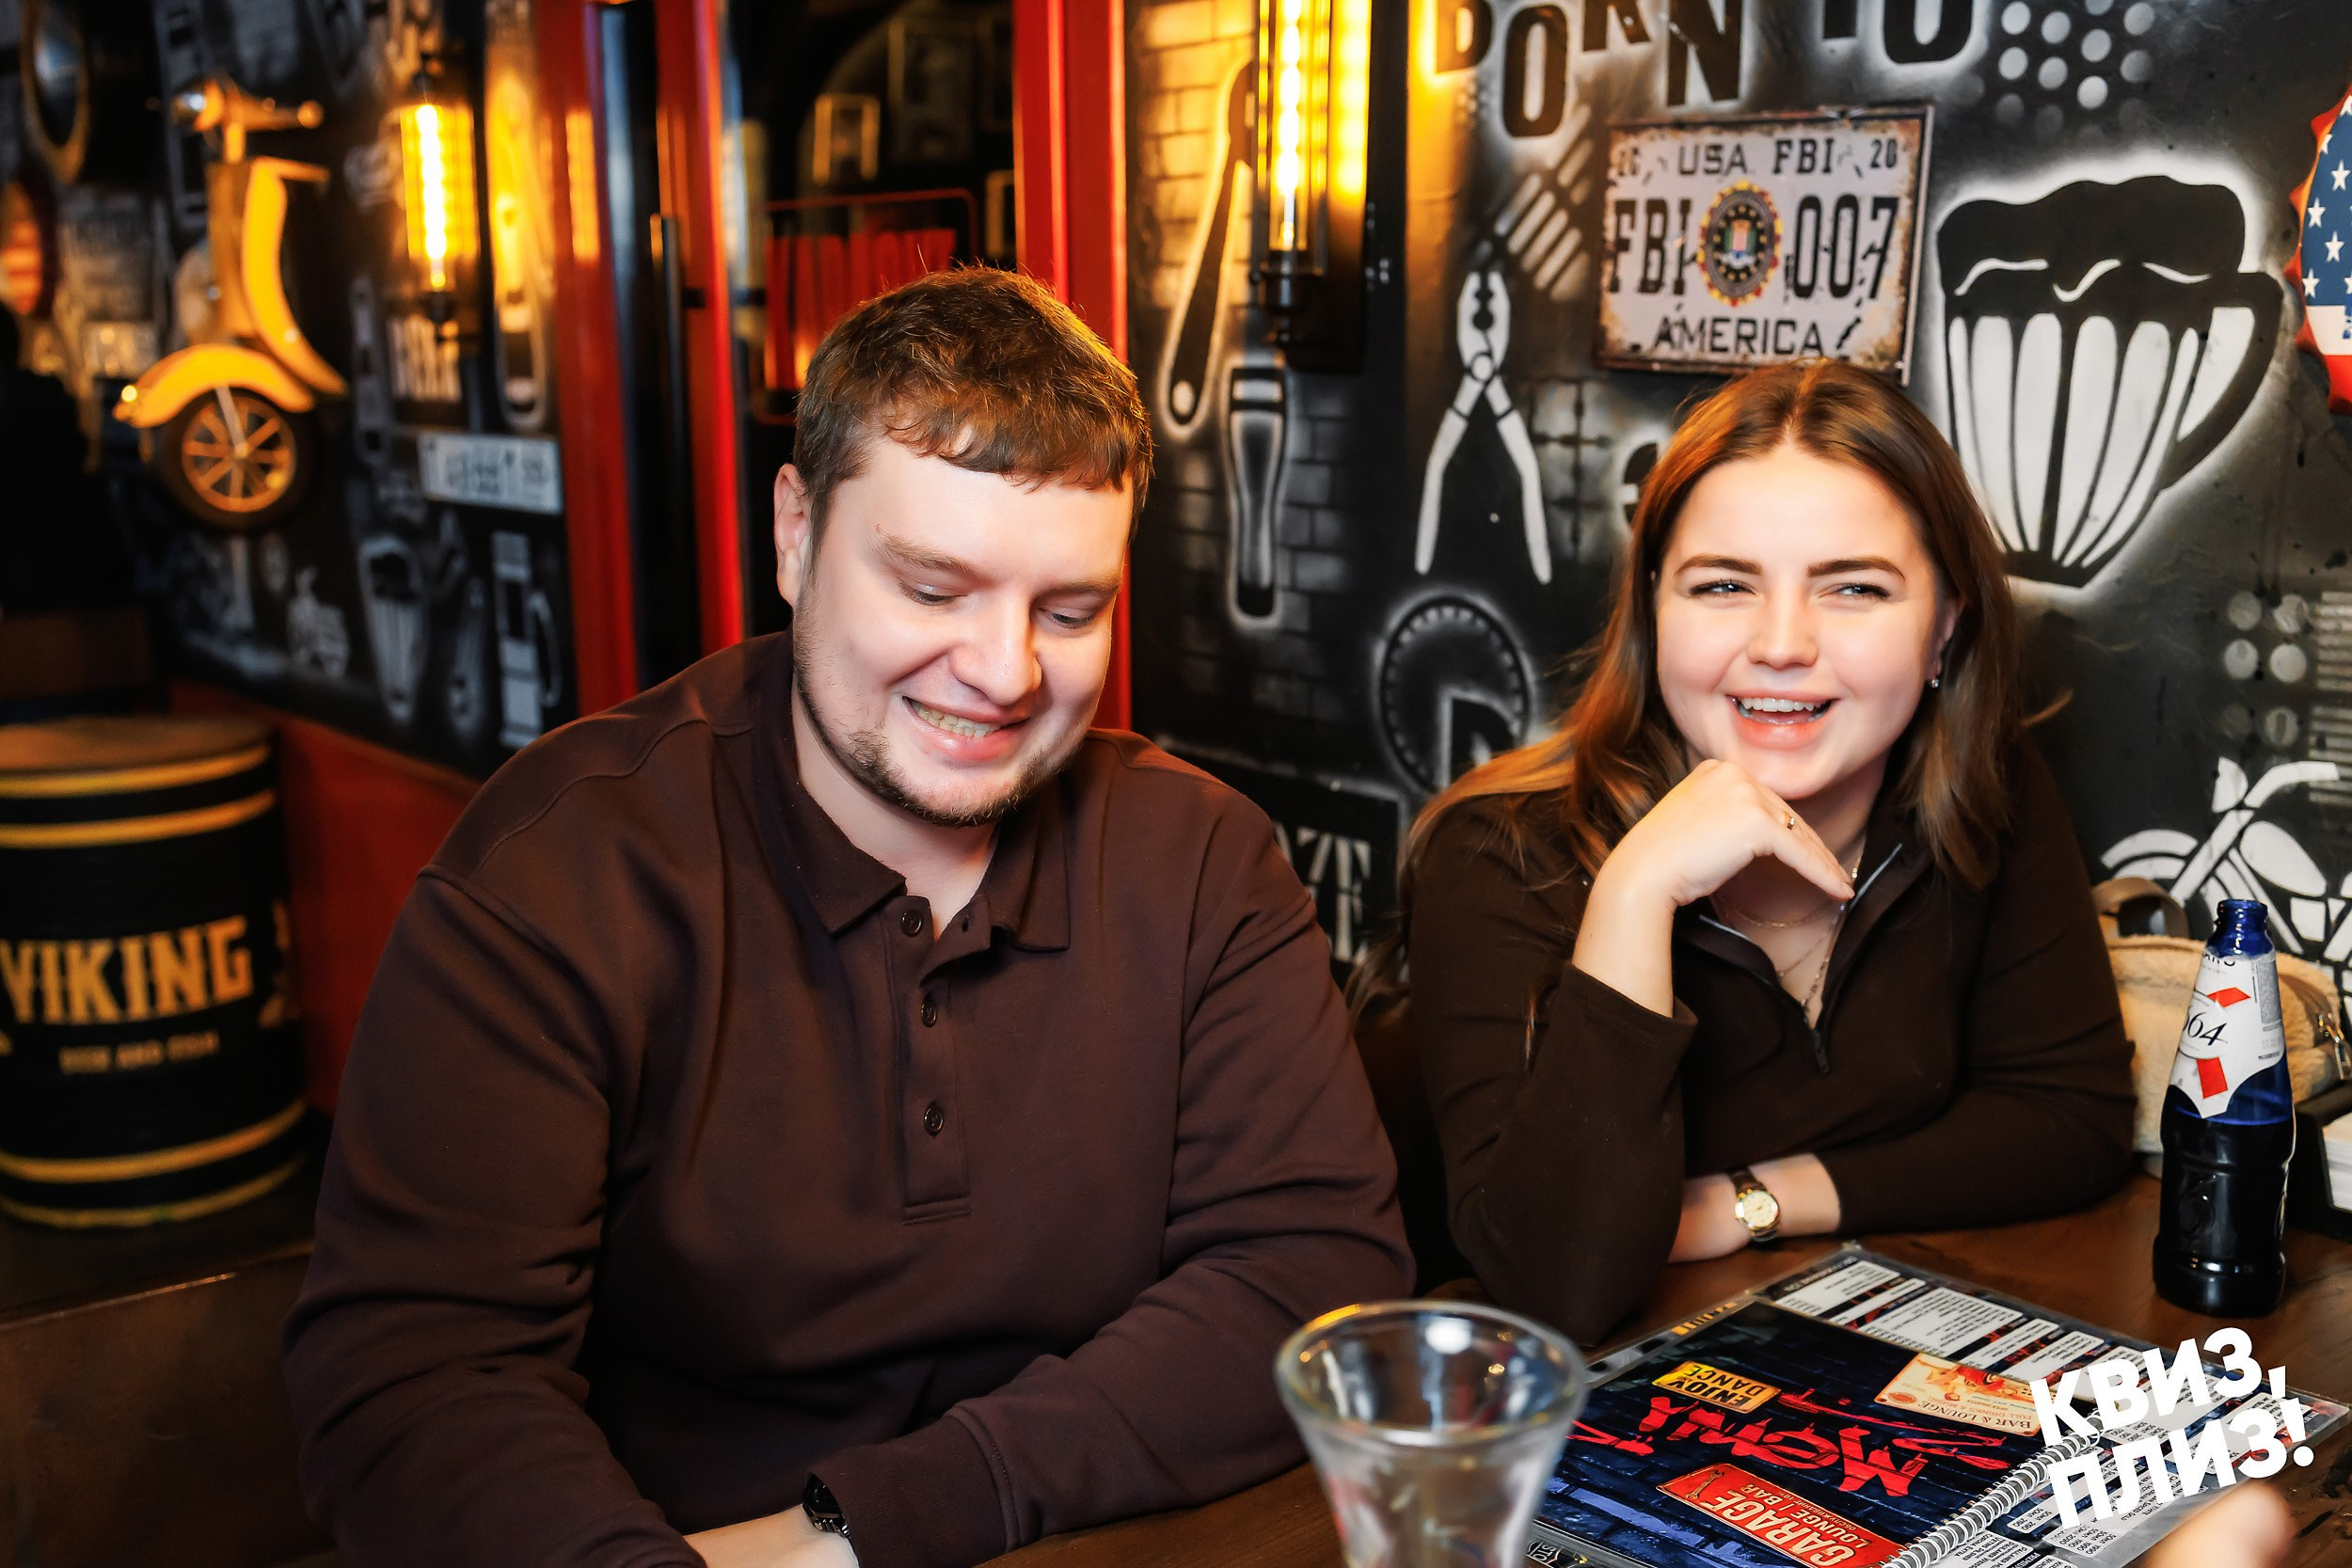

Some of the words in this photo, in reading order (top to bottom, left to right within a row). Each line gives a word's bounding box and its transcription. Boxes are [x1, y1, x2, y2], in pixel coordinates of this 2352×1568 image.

[1678, 142, 1749, 177] USA
[1772, 138, 1835, 175] FBI
[1608, 197, 1692, 297] FBI
[1793, 193, 1900, 300] 007
[1653, 316, 1824, 356] AMERICA
[0, 914, 253, 1024] VIKING
[1666, 1381, 1752, 1407] ENJOY
[1682, 1365, 1766, 1396] DANCE
[1916, 1400, 1978, 1419] LOUNGE
[1995, 1418, 2030, 1428] BAR
[1739, 1483, 1783, 1505] BAR
[1699, 1489, 1856, 1566] GARAGE
[1788, 1508, 1870, 1547] LOUNGE
[1792, 1498, 1857, 1530] ОБСЛУЖИВАНИЕ
[1953, 1545, 1973, 1558] EXTRA
